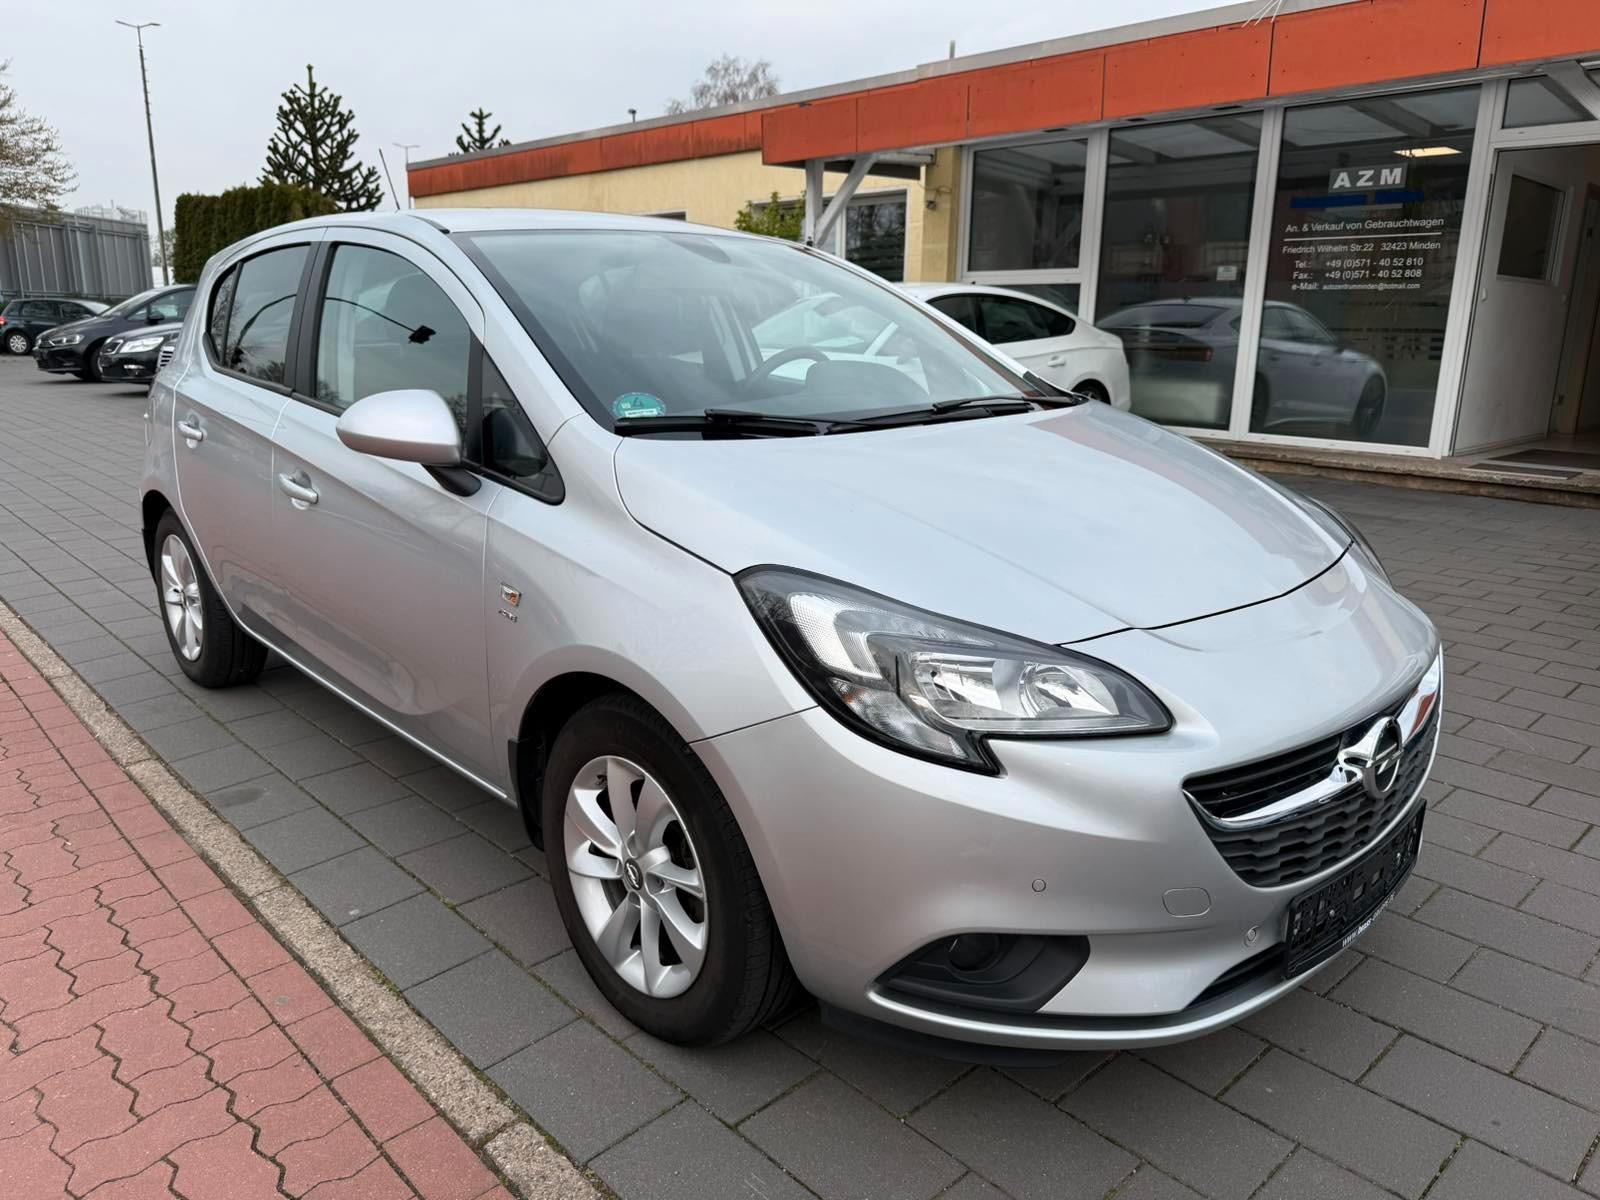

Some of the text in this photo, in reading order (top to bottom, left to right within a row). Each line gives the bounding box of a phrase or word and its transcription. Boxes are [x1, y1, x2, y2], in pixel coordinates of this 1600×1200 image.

[1301, 222, 1309, 232] &
[1311, 221, 1344, 232] Verkauf
[1345, 221, 1362, 230] von
[1364, 218, 1445, 229] Gebrauchtwagen
[1282, 245, 1316, 254] Friedrich
[1317, 244, 1349, 253] Wilhelm
[1380, 241, 1408, 251] 32423
[1409, 241, 1441, 250] Minden
[1326, 259, 1341, 268] +49
[1343, 258, 1371, 269] (0)571
[1379, 258, 1391, 267] 40
[1392, 257, 1404, 267] 52
[1406, 256, 1424, 266] 810
[1325, 270, 1341, 279] +49
[1342, 269, 1370, 280] (0)571
[1377, 269, 1389, 278] 40
[1390, 268, 1403, 278] 52
[1404, 268, 1423, 278] 808
